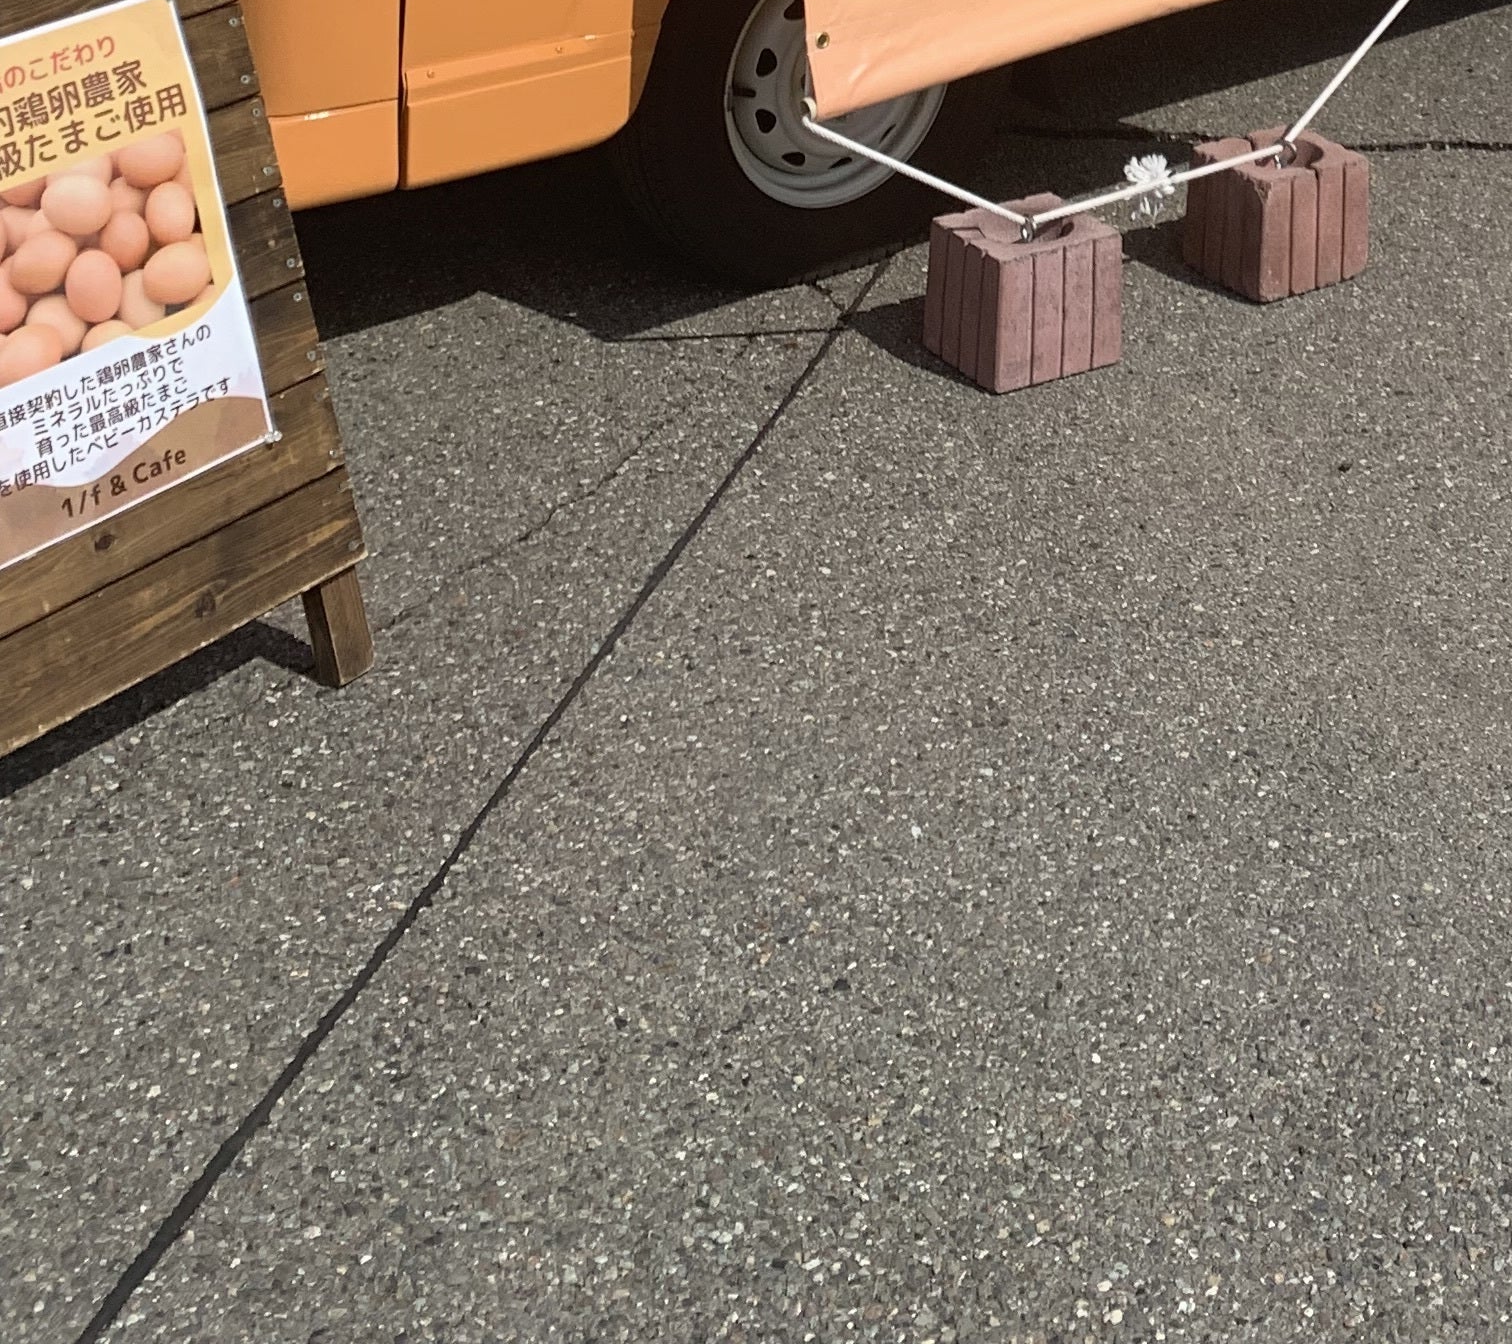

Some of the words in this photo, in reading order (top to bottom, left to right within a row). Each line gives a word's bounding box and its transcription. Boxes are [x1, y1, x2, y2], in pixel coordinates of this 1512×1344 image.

[0, 35, 116, 95] のこだわり
[32, 356, 184, 437] ミネラルたっぷりで
[35, 376, 188, 459] 育った最高級たまご
[61, 484, 102, 518] 1/f
[109, 474, 128, 497] &
[132, 448, 187, 485] Cafe
